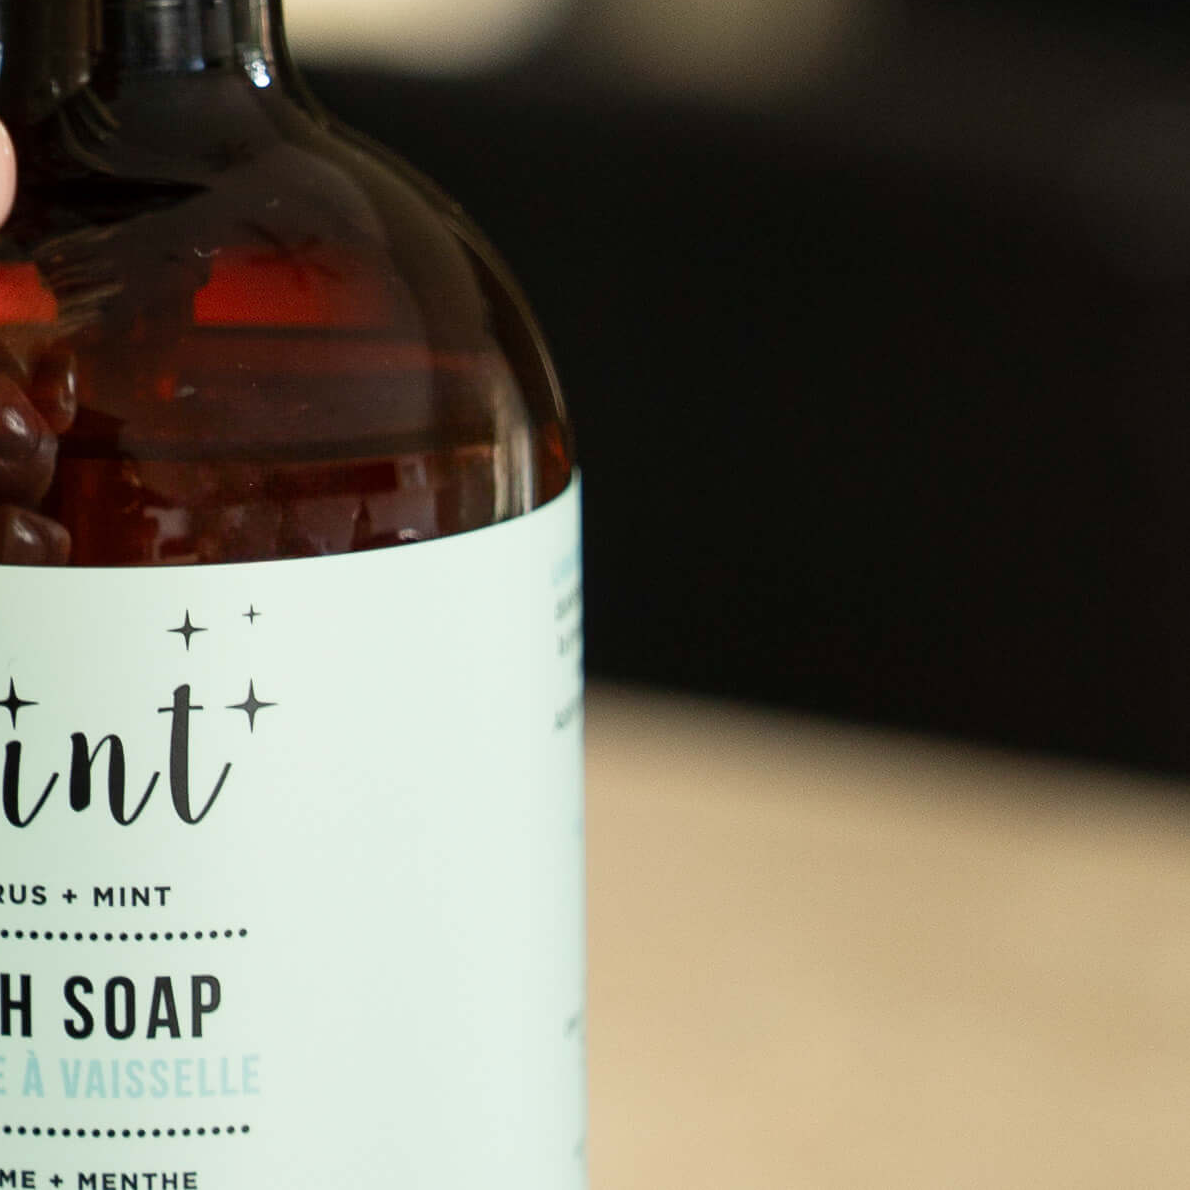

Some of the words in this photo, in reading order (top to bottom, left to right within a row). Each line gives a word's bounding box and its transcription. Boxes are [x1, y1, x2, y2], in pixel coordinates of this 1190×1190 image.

[93, 886, 172, 907] MINT
[63, 974, 222, 1040] SOAP
[22, 1050, 45, 1098] À
[59, 1053, 262, 1099] VAISSELLE
[78, 1171, 198, 1190] MENTHE
